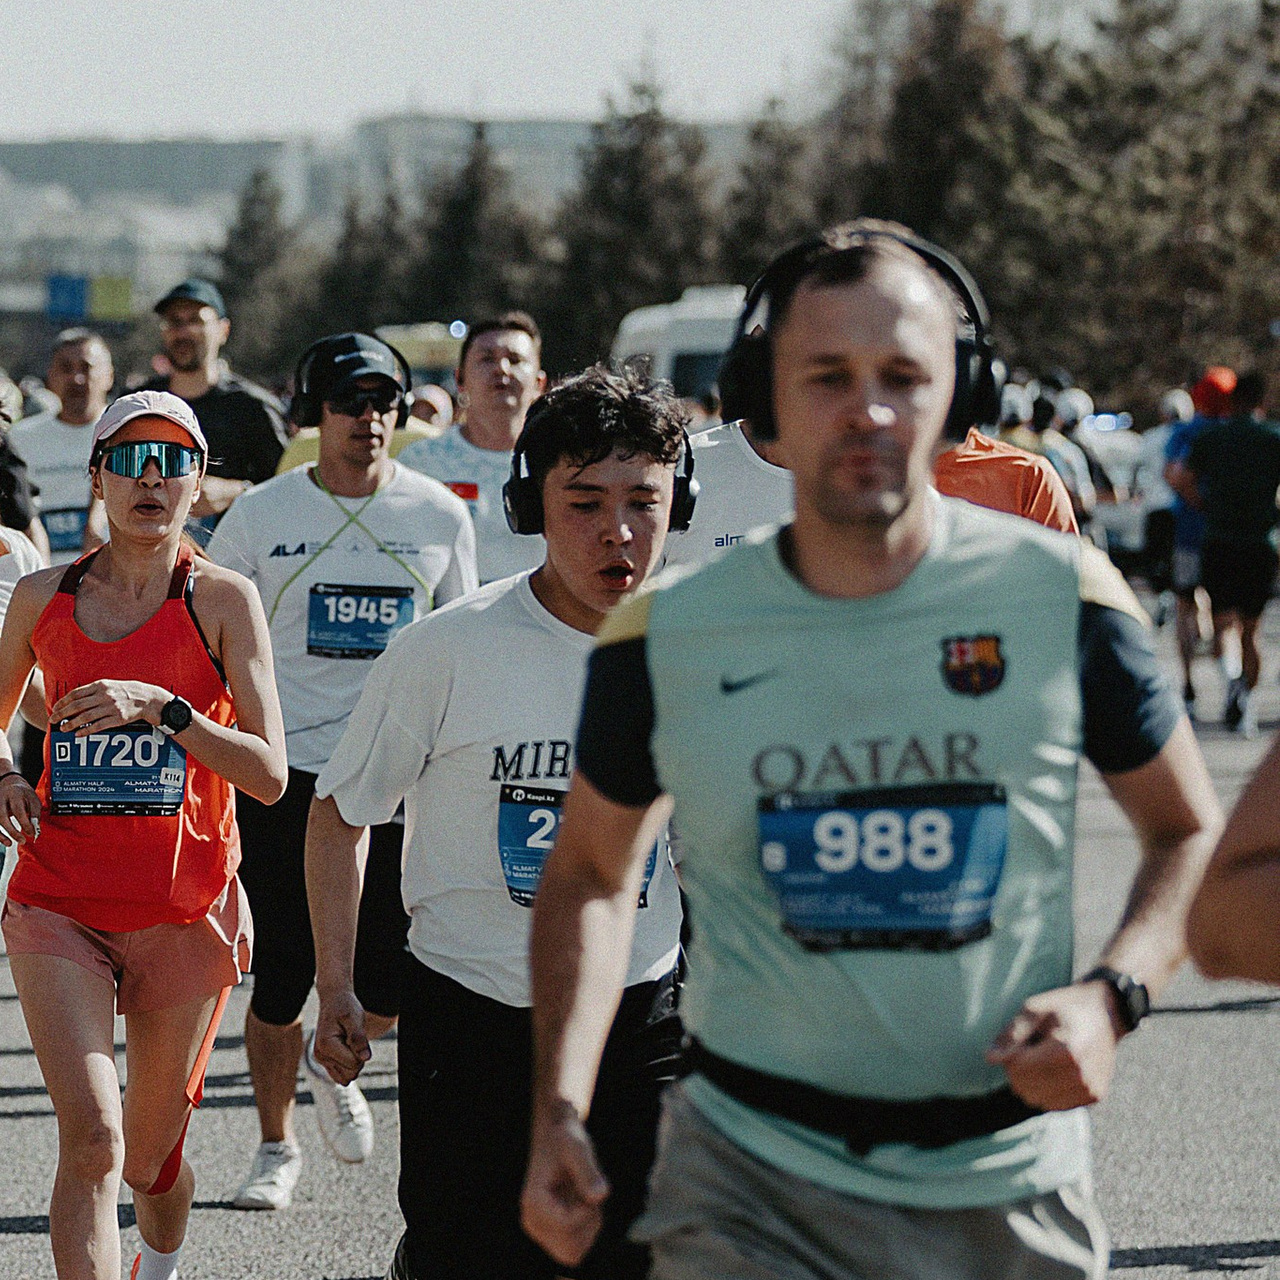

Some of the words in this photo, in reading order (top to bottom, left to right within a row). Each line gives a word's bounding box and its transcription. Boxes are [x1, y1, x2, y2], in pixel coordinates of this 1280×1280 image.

[270, 543, 306, 557] ALA
[324, 596, 399, 625] 1945
[58, 744, 69, 760] D
[75, 734, 159, 768] 1720
[751, 732, 981, 793] QATAR
[527, 793, 555, 802] Kaspi.kz
[813, 808, 954, 872] 988
